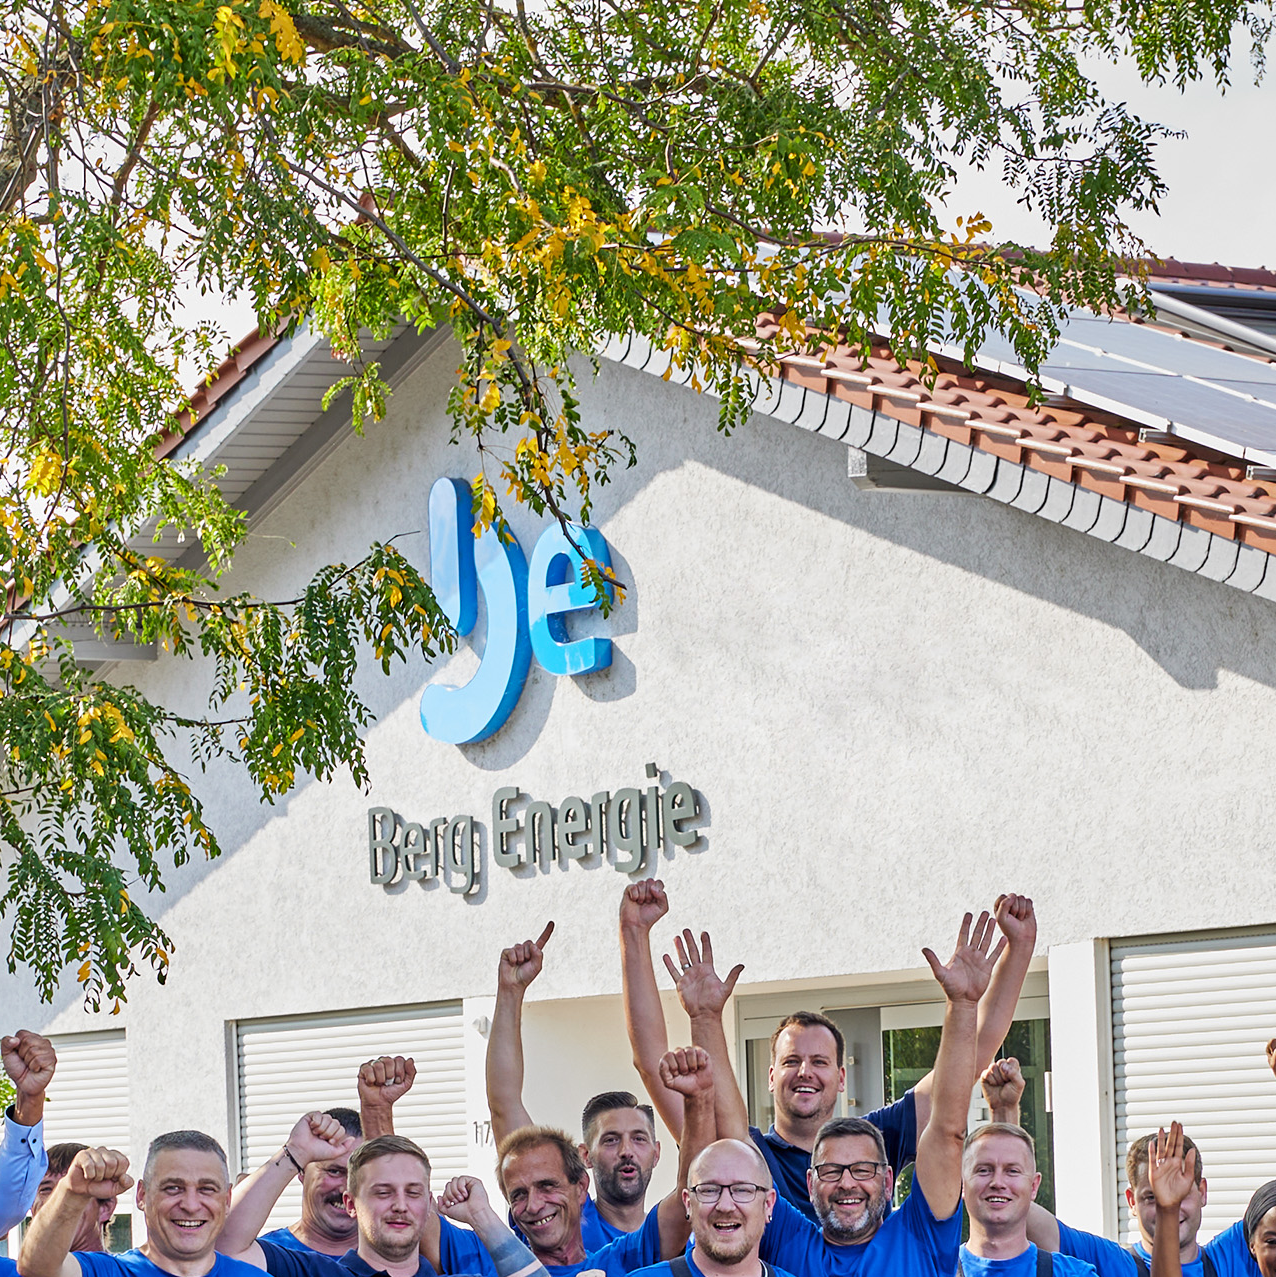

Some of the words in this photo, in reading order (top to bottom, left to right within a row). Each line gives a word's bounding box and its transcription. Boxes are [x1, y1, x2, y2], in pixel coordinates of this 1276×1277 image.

[368, 806, 476, 895] Berg
[492, 762, 700, 874] Energie
[473, 1120, 491, 1144] 17
